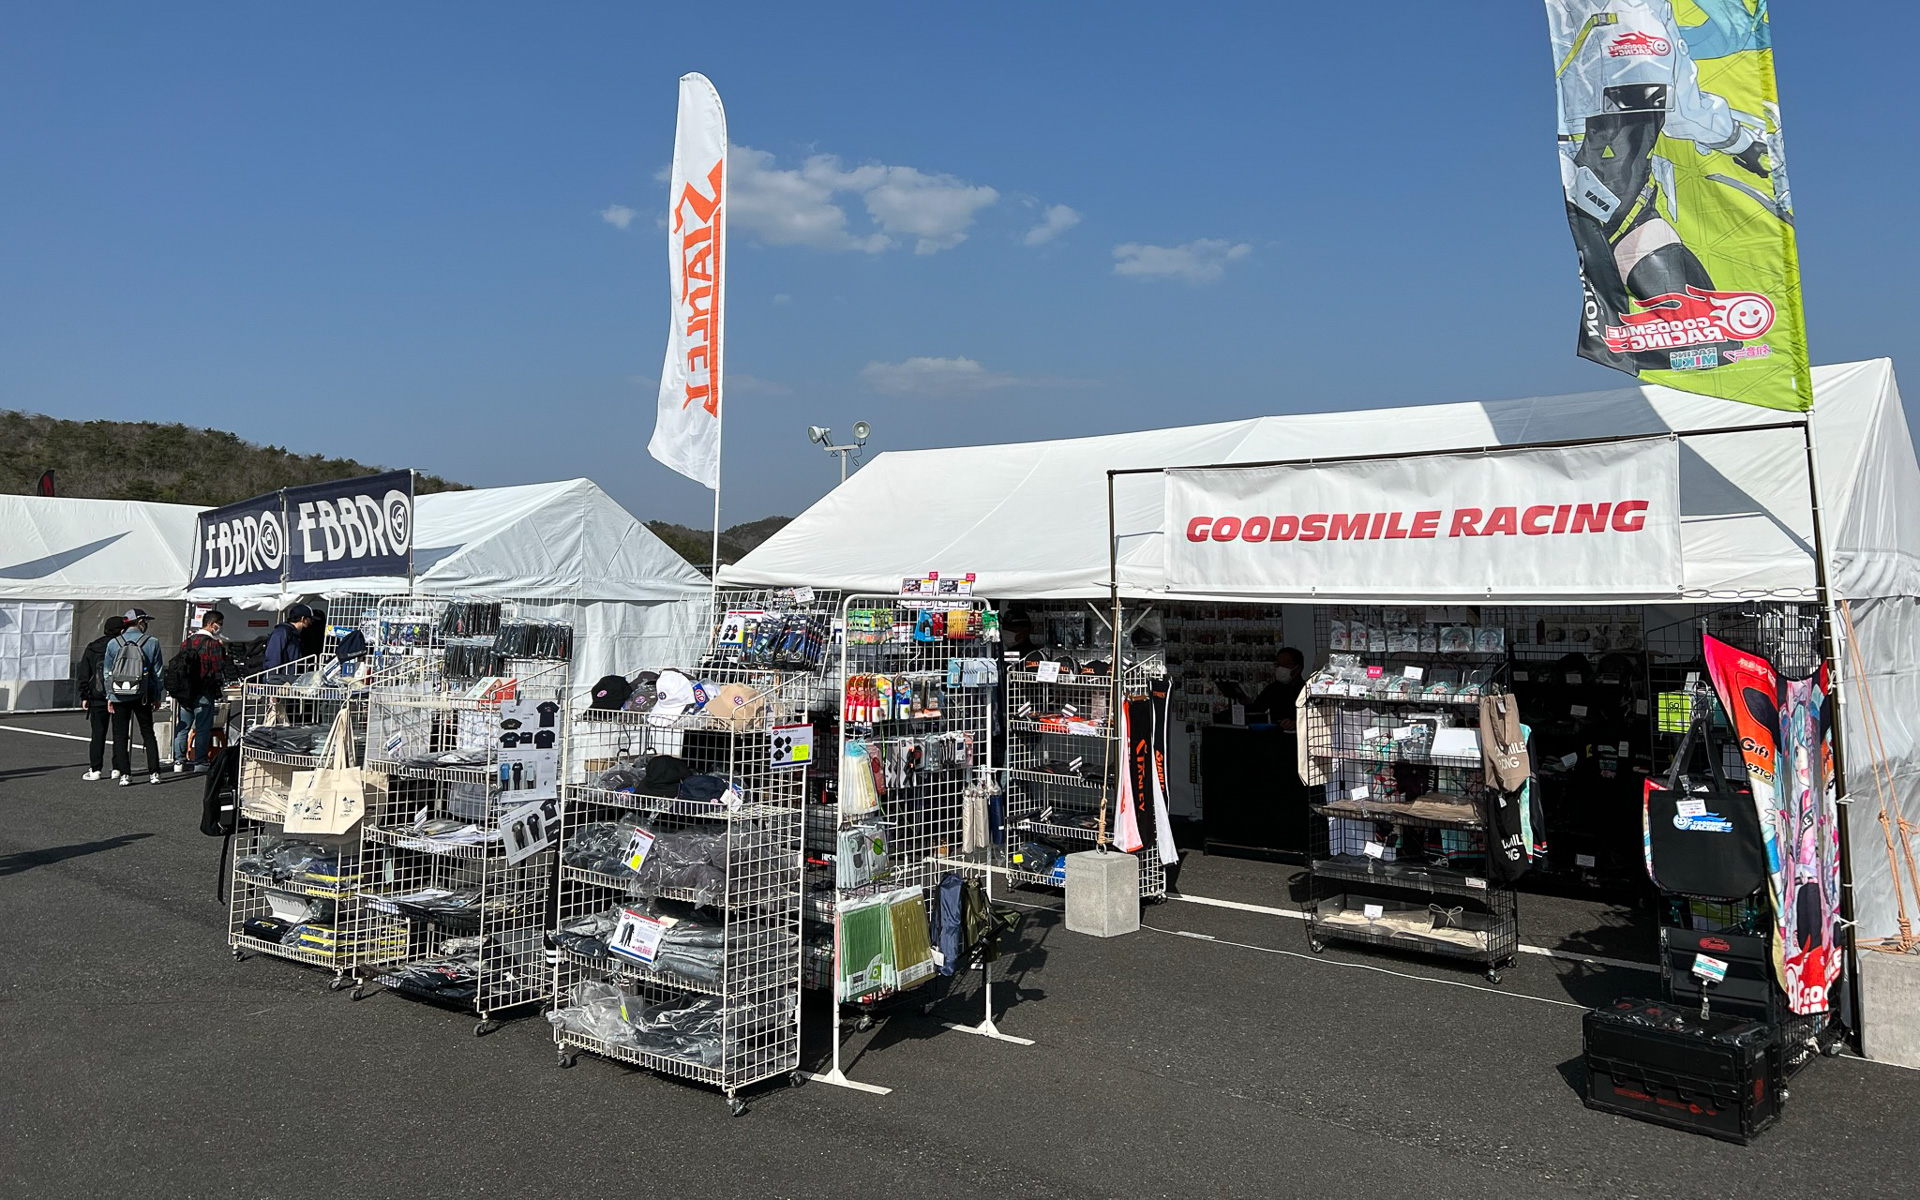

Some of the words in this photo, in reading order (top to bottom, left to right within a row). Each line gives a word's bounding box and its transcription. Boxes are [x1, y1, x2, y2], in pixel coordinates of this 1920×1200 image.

[204, 510, 284, 579] EBBRO
[297, 489, 412, 563] EBBRO
[1186, 509, 1443, 543] GOODSMILE
[1448, 500, 1650, 537] RACING
[1740, 736, 1770, 760] Gift
